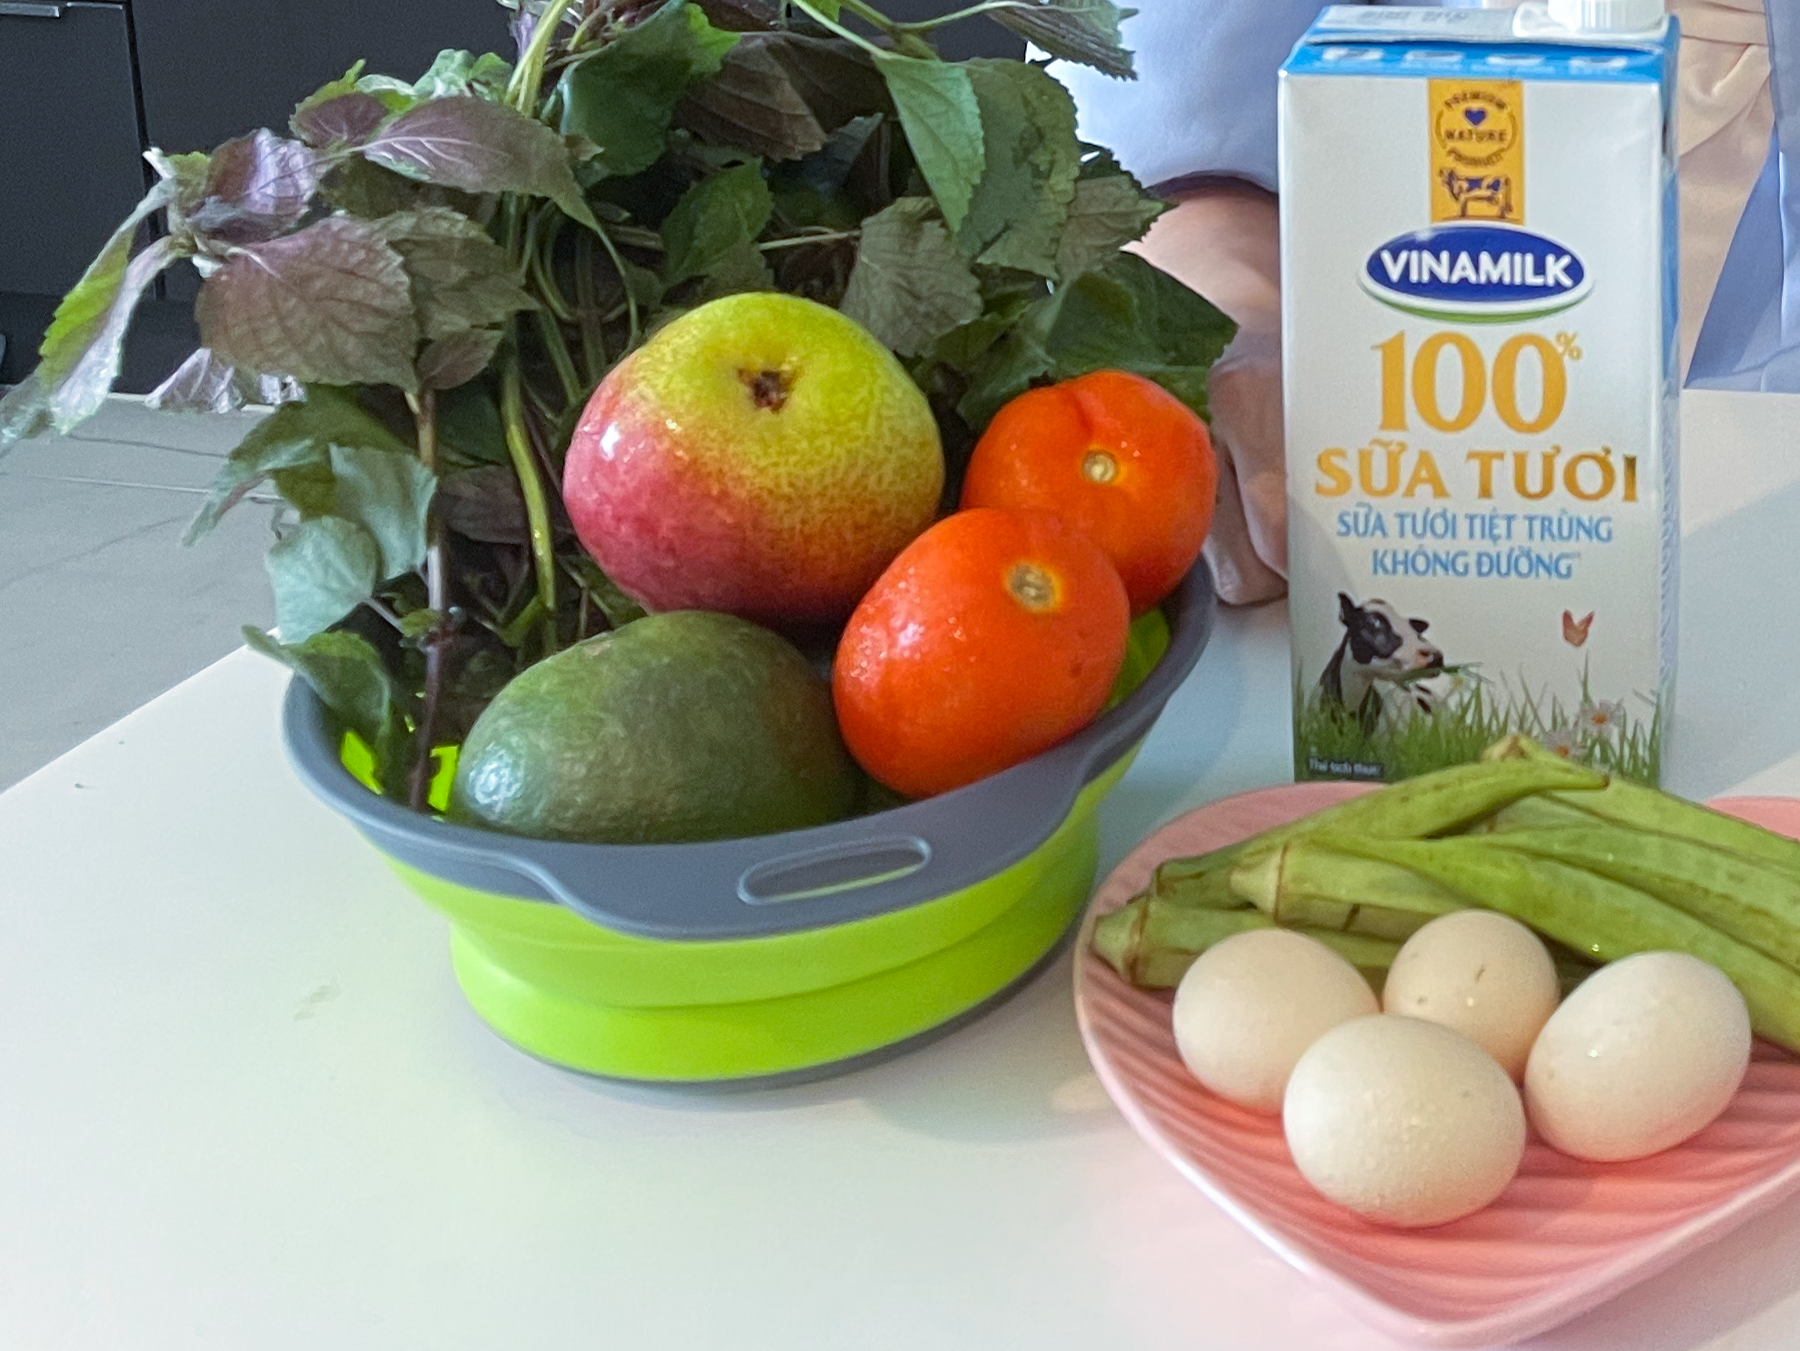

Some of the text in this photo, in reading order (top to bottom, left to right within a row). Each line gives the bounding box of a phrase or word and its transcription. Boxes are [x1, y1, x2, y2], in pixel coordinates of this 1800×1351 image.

[1379, 249, 1574, 288] VINAMILK
[1314, 438, 1639, 503] SỮA TƯƠI
[1336, 501, 1613, 548] SỮA TƯƠI TIỆT TRÙNG
[1371, 543, 1470, 579] KHÔNG
